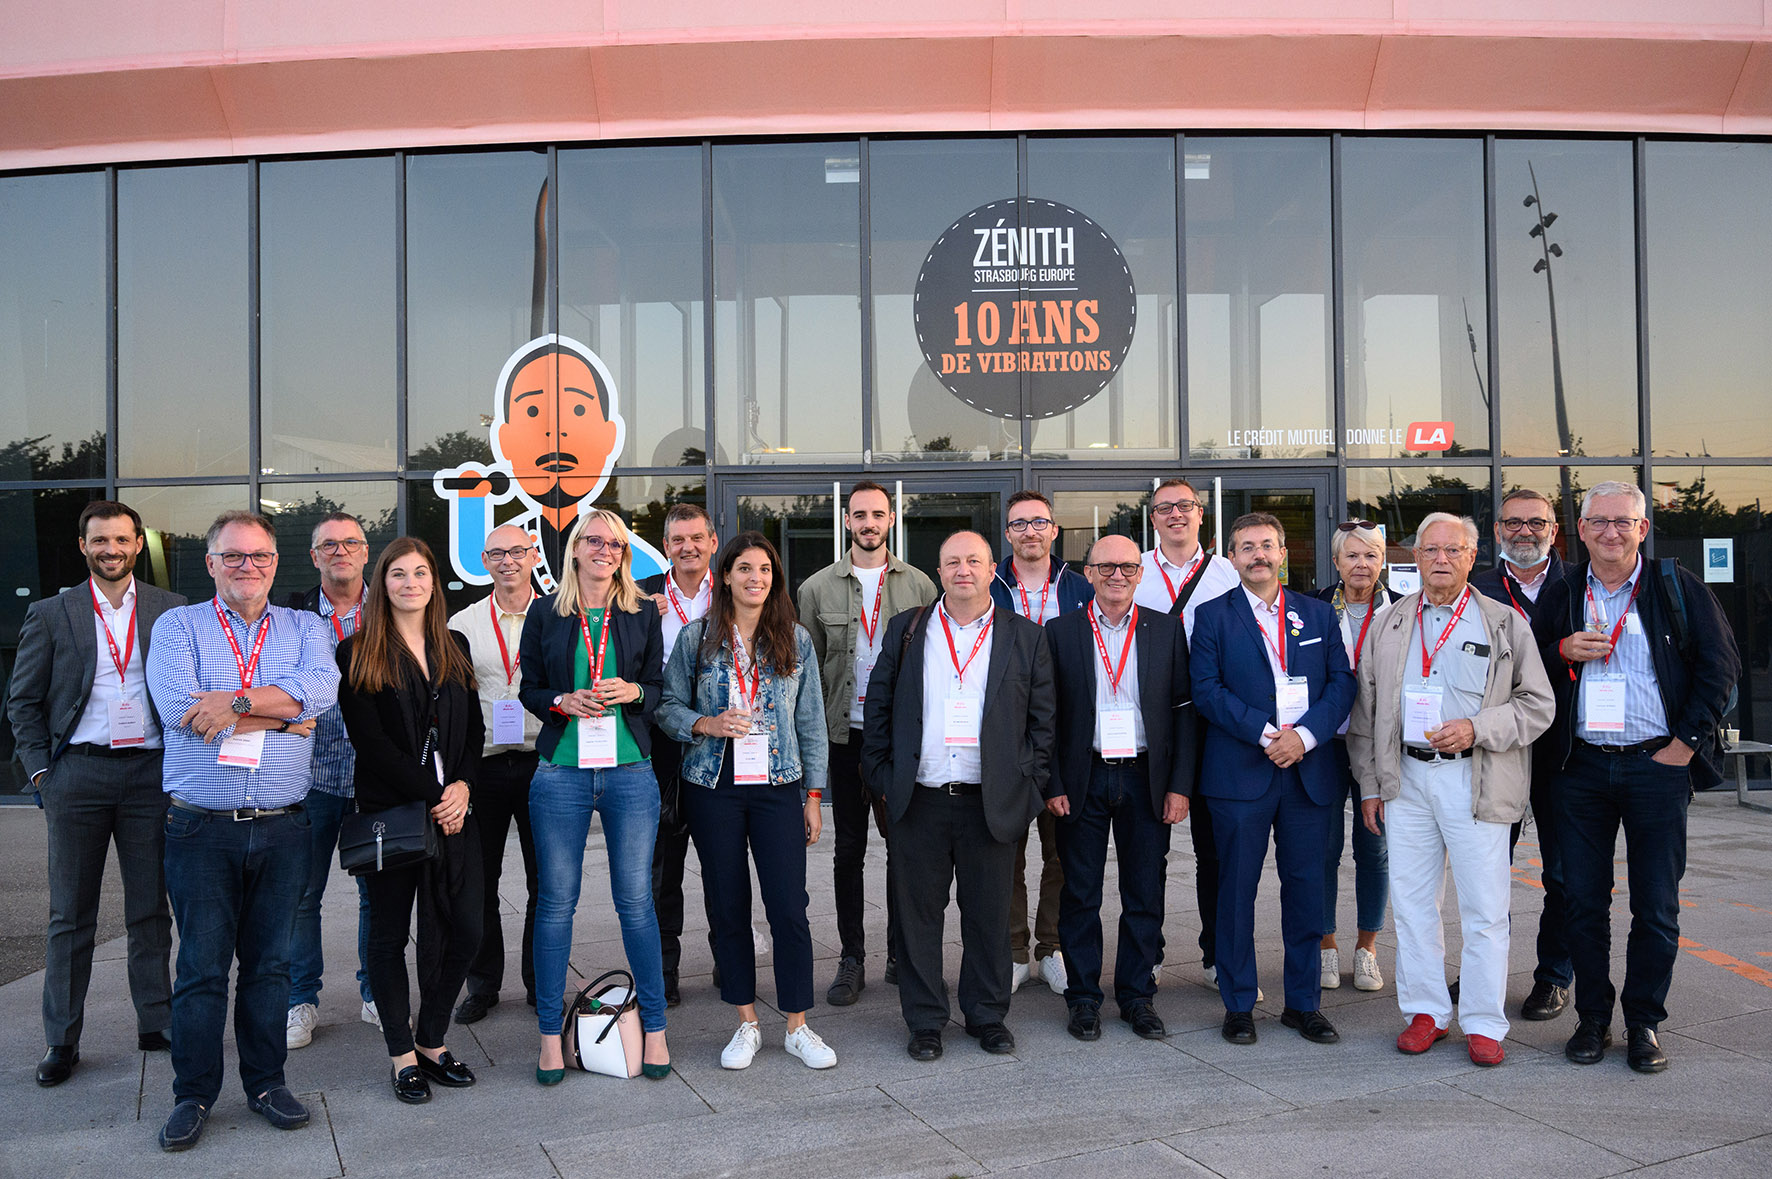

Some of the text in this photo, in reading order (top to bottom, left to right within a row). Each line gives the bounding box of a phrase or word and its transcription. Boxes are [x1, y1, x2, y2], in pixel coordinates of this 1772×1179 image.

[973, 218, 1075, 267] ZÉNITH
[974, 267, 1075, 283] STRASBOURG EUROPE
[954, 299, 1100, 346] 10 ANS
[941, 350, 1111, 374] DE VIBRATIONS
[1227, 426, 1447, 446] LE CRÉDIT MUTUEL DONNE LE LA
